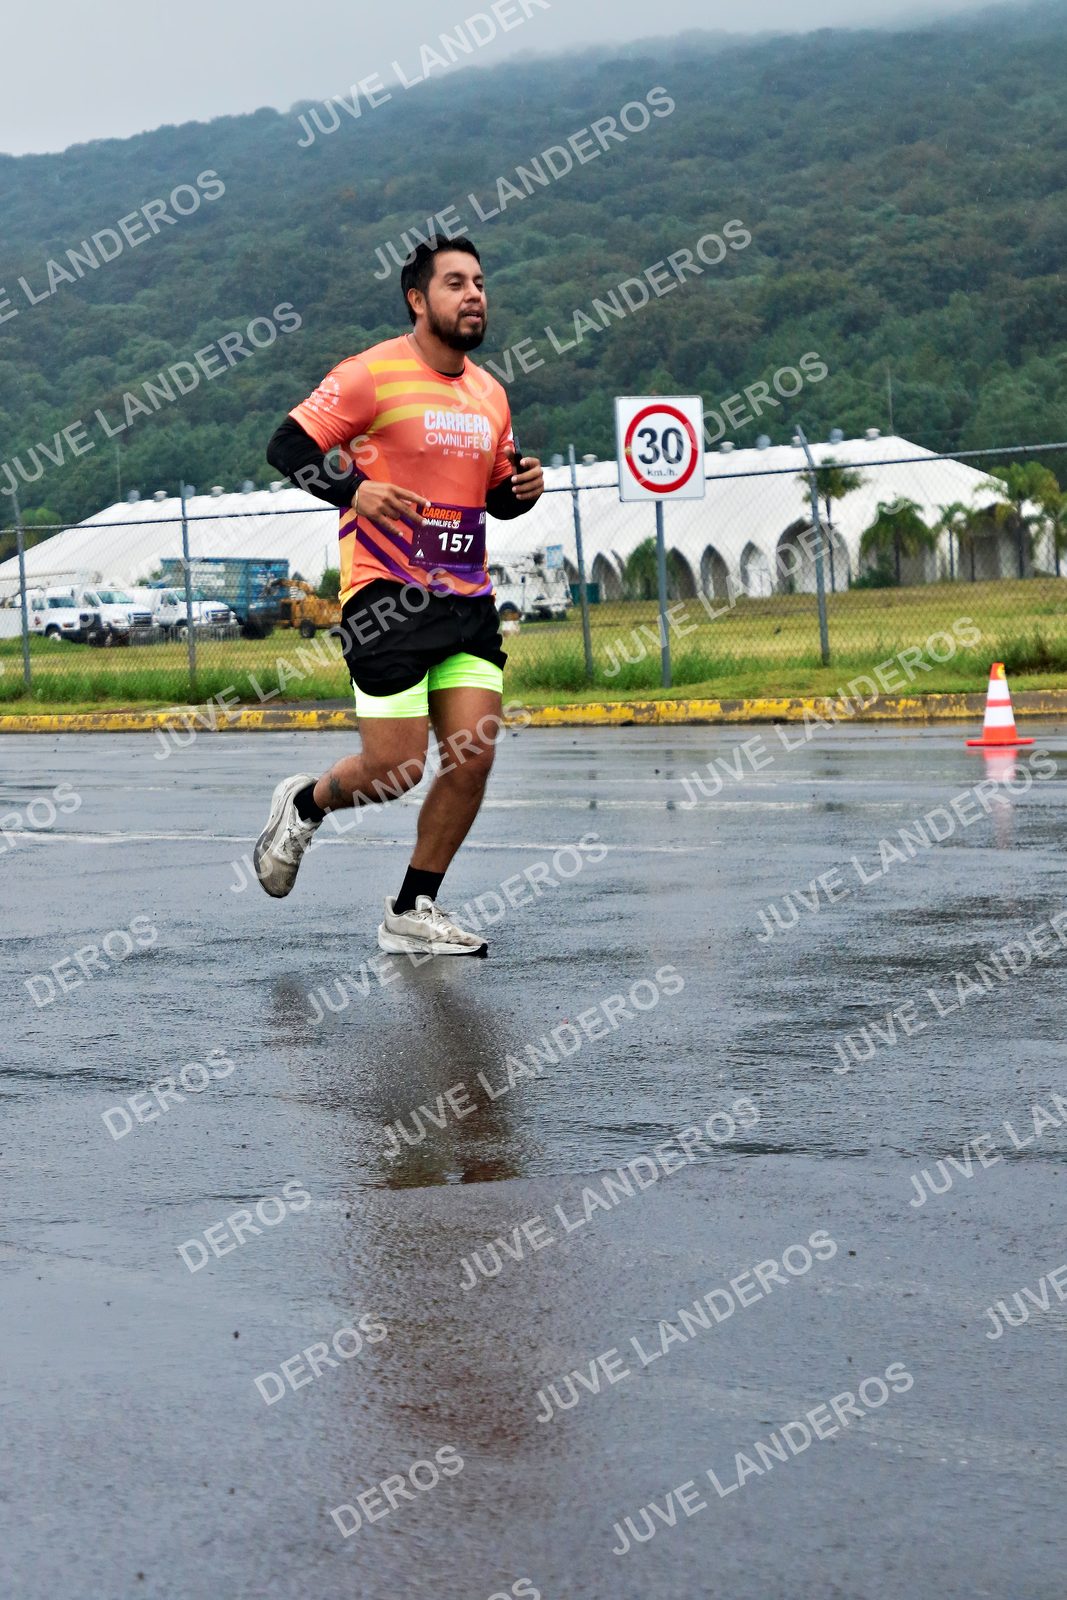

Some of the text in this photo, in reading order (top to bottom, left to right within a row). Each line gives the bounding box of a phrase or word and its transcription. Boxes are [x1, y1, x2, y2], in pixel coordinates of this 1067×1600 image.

[424, 410, 491, 436] CARRERA
[425, 432, 480, 449] OMNILIFE
[637, 427, 684, 465] 30
[422, 507, 462, 521] CARRERA
[438, 532, 474, 553] 157
